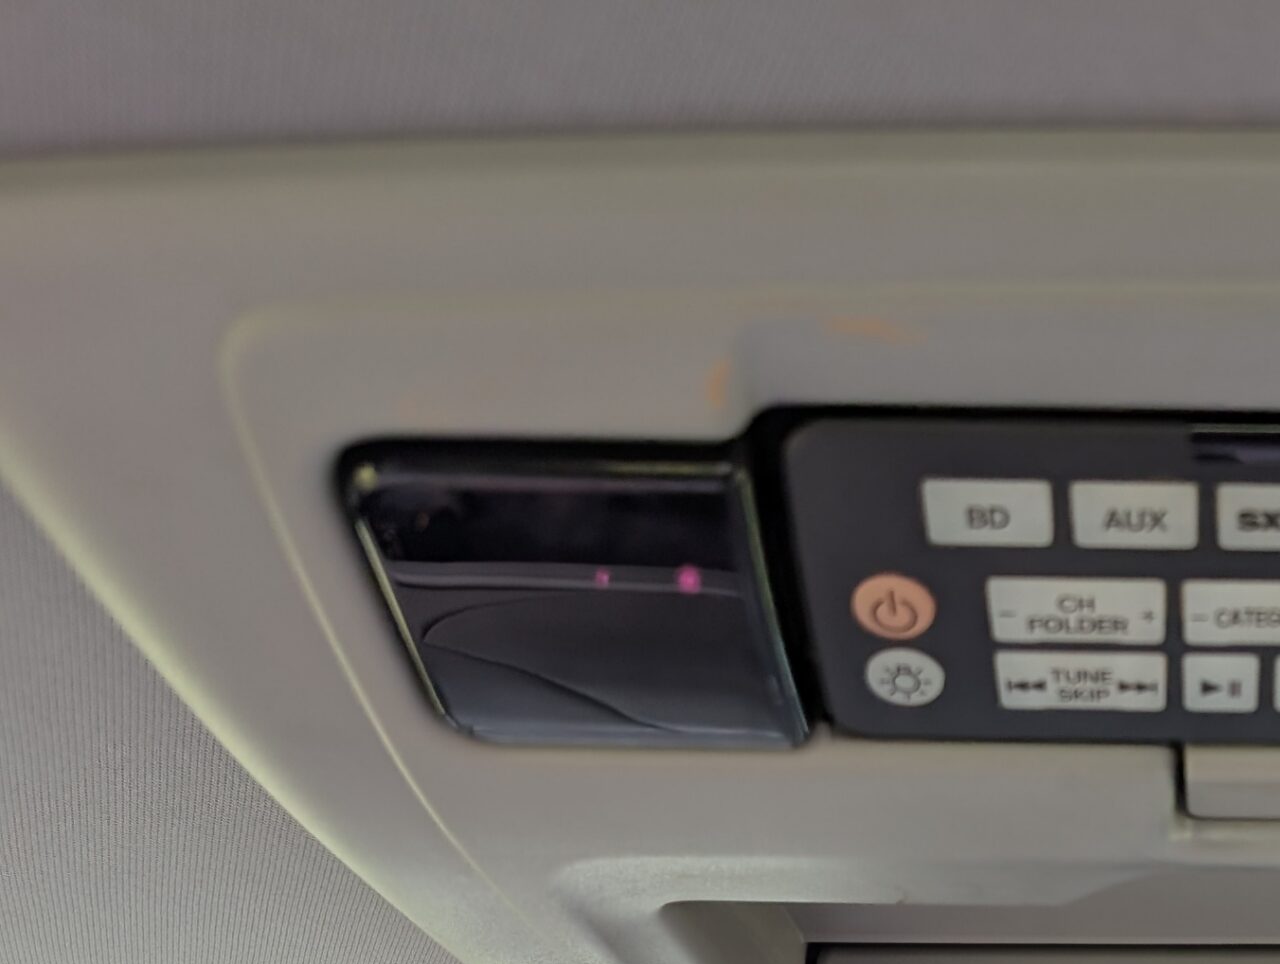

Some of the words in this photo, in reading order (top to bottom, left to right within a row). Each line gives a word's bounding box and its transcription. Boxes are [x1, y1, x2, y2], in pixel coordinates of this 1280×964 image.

[966, 505, 1010, 530] BD
[1104, 507, 1168, 533] AUX
[1057, 594, 1096, 614] CH
[1027, 615, 1129, 635] FOLDER
[1050, 669, 1113, 685] TUNE
[1058, 687, 1110, 702] SKIP
